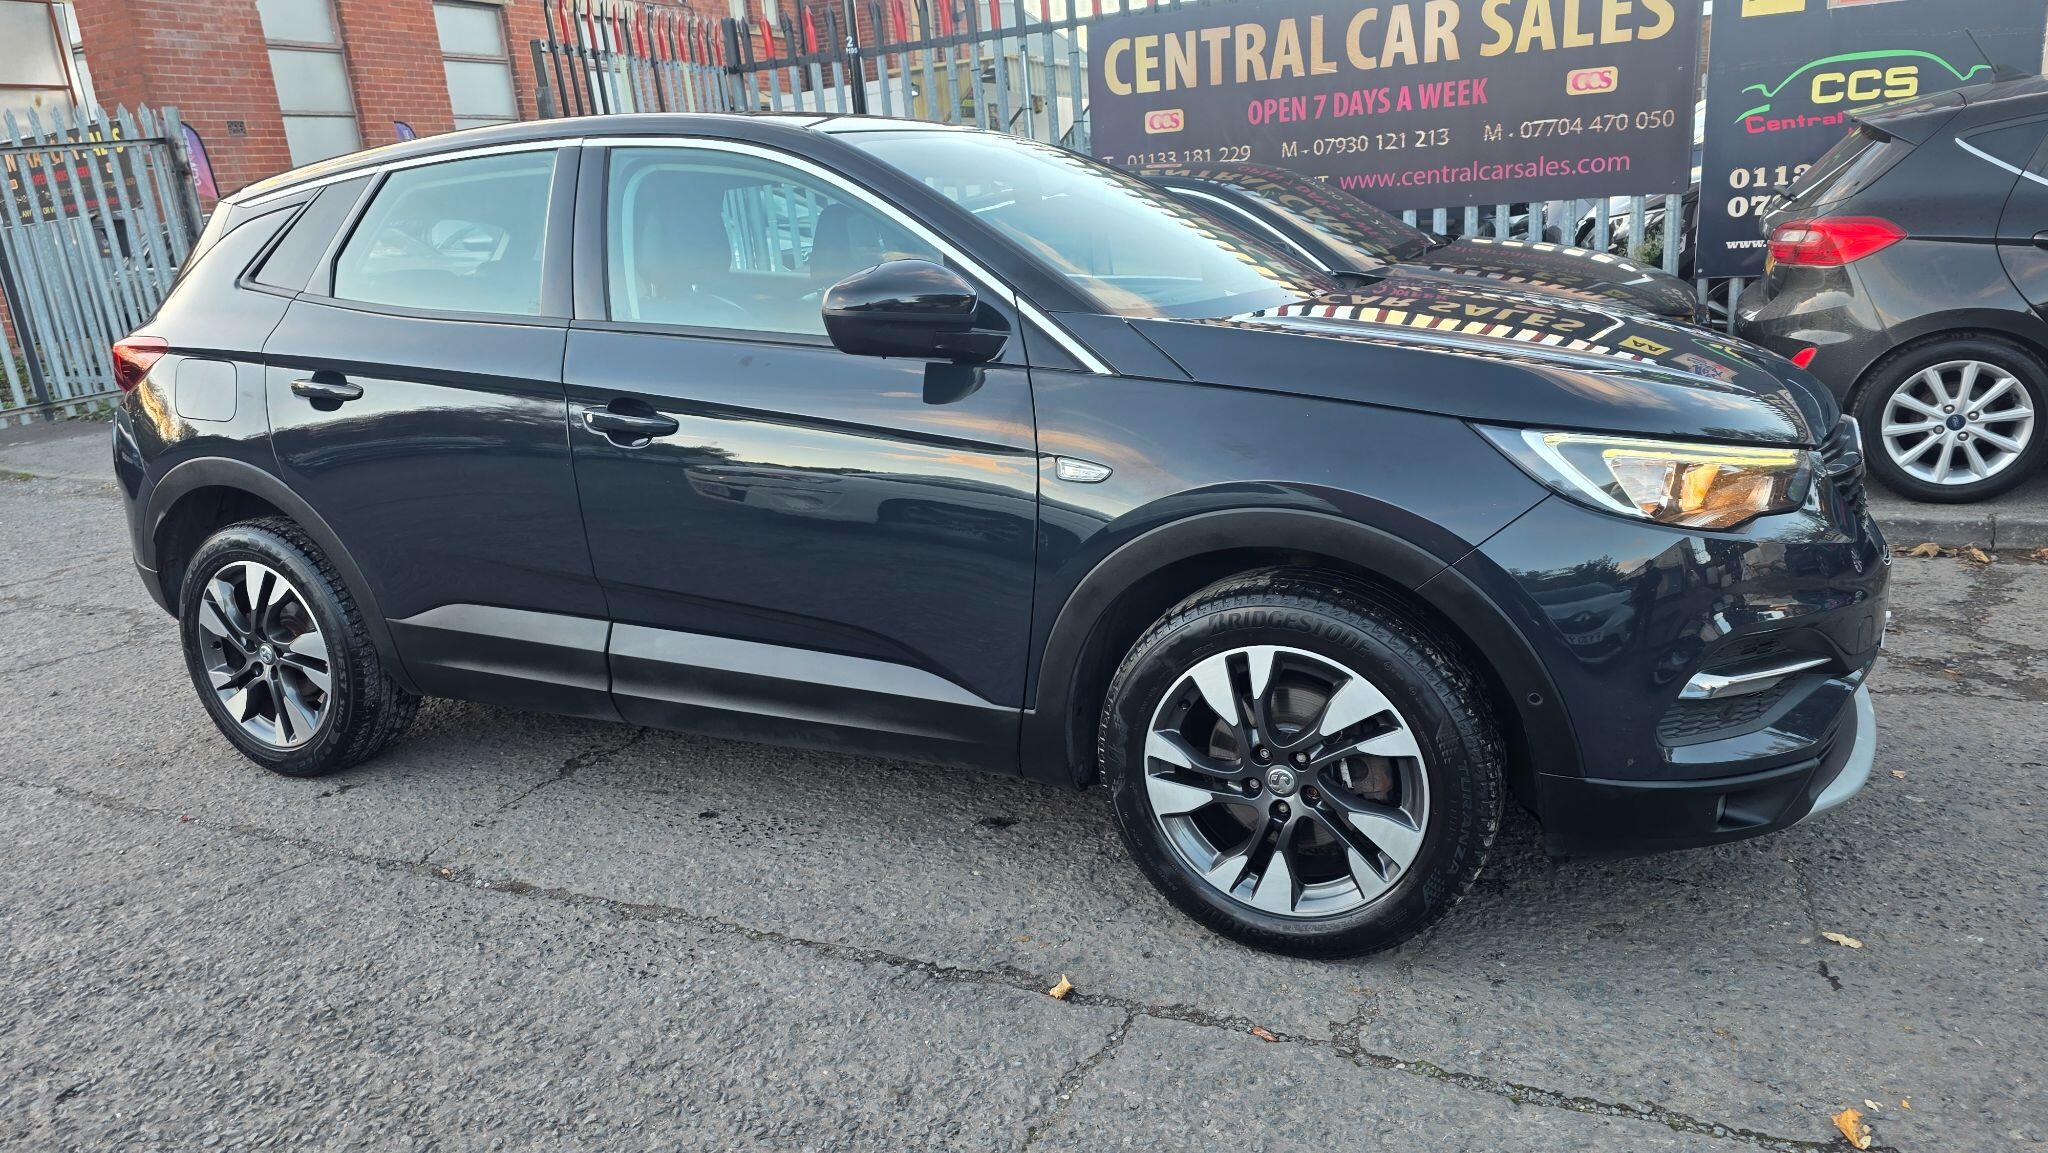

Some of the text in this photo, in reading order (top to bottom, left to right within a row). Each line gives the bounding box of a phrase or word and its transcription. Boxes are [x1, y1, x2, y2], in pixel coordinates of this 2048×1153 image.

[1104, 0, 1675, 95] CENTRAL CAR SALES
[1247, 77, 1488, 126] OPEN 7 DAYS A WEEK
[1811, 65, 1919, 104] CCS
[1520, 117, 1583, 139] 07704
[1588, 114, 1629, 133] 470
[1635, 109, 1675, 130] 050
[1745, 112, 1844, 134] Central
[1219, 145, 1251, 162] 229
[1313, 134, 1369, 156] 07930
[1376, 132, 1406, 150] 121
[1414, 128, 1450, 148] 213
[1339, 154, 1630, 190] www.centralcarsales.com
[1208, 610, 1376, 658] BRIDGESTONE
